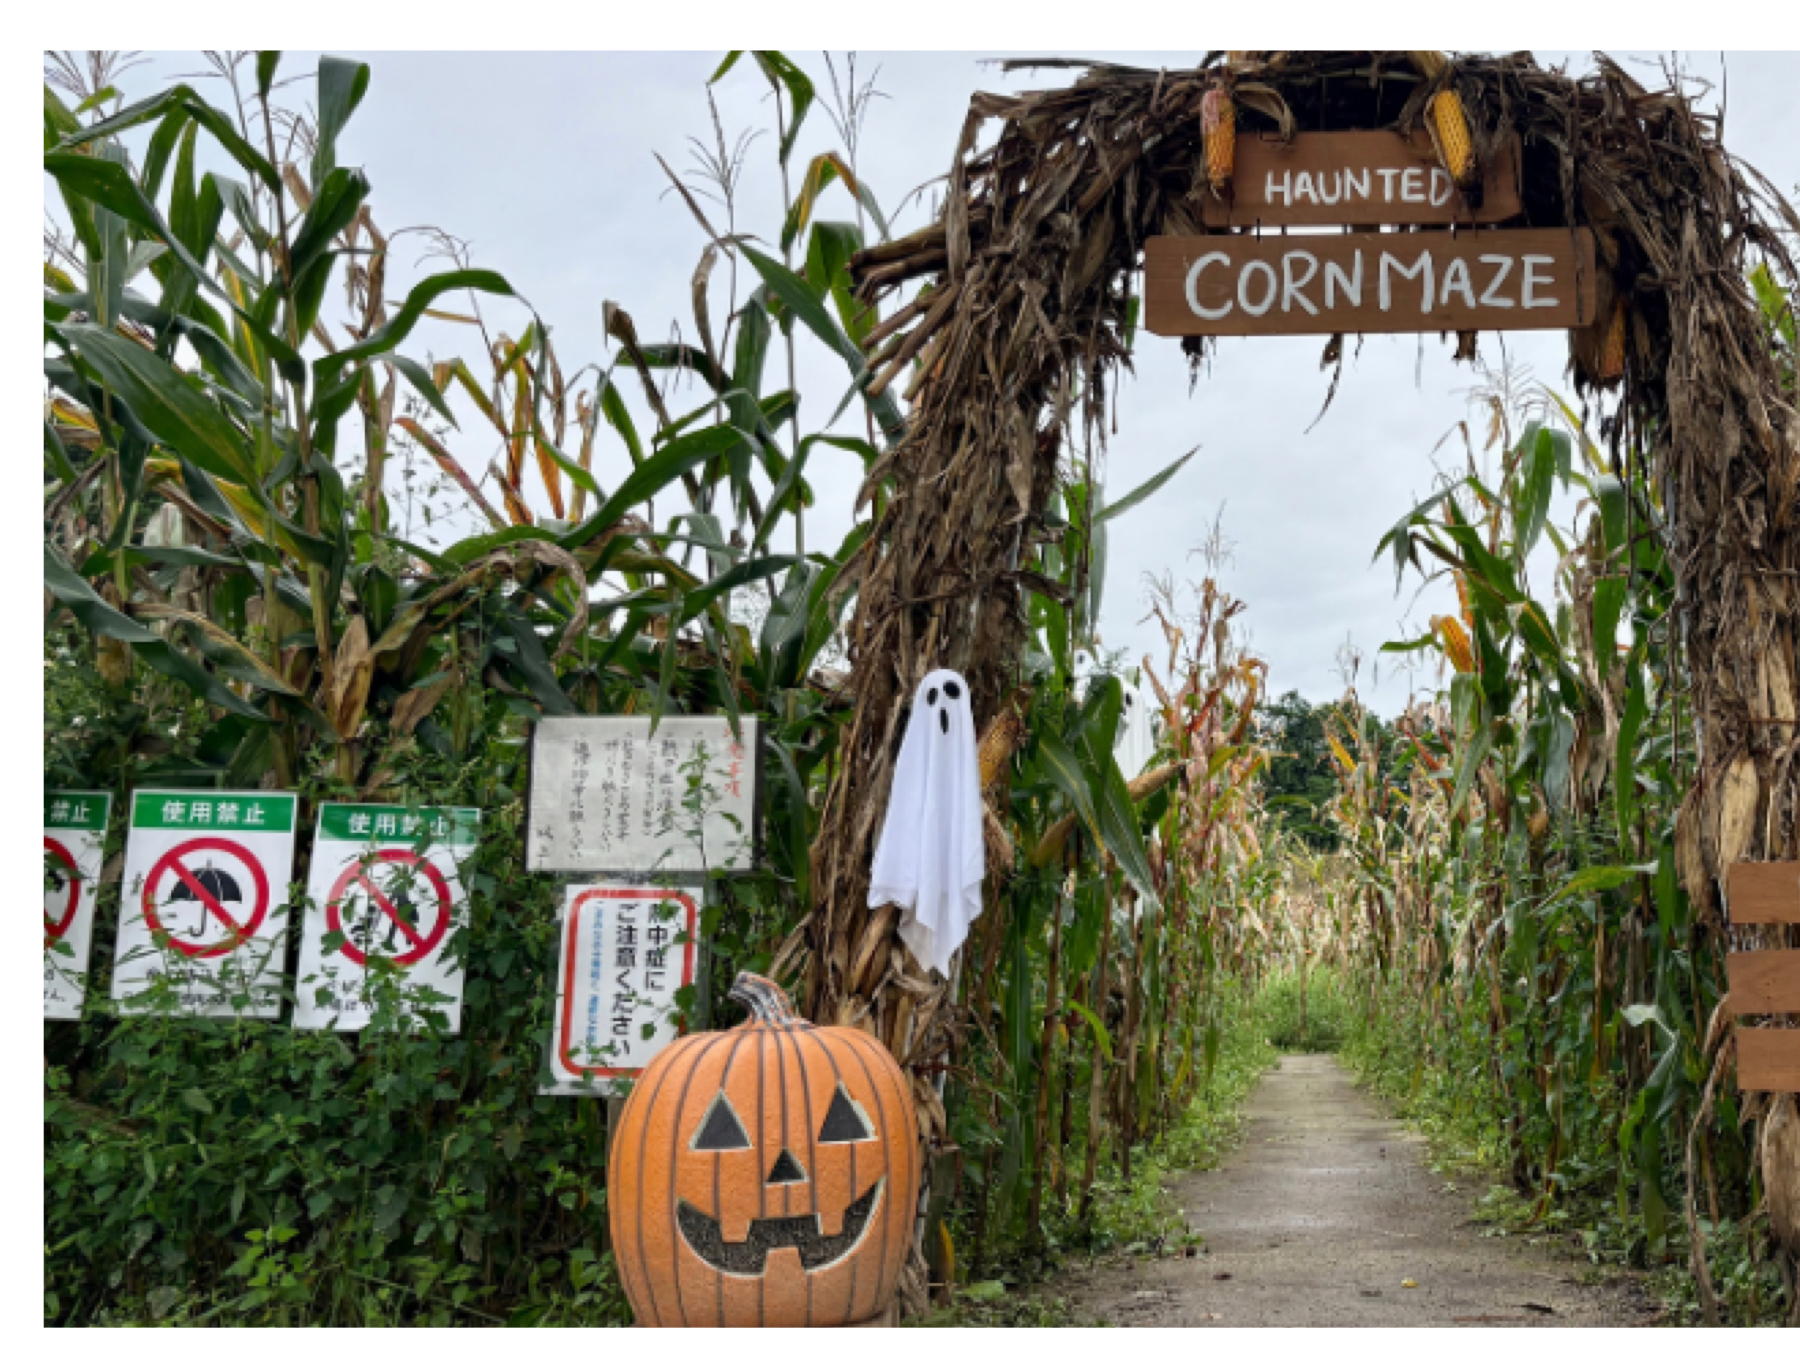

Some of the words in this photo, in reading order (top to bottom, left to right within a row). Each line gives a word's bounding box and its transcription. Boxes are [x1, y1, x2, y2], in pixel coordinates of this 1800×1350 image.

[1265, 166, 1454, 208] HAUNTED
[161, 799, 267, 826] 使用禁止
